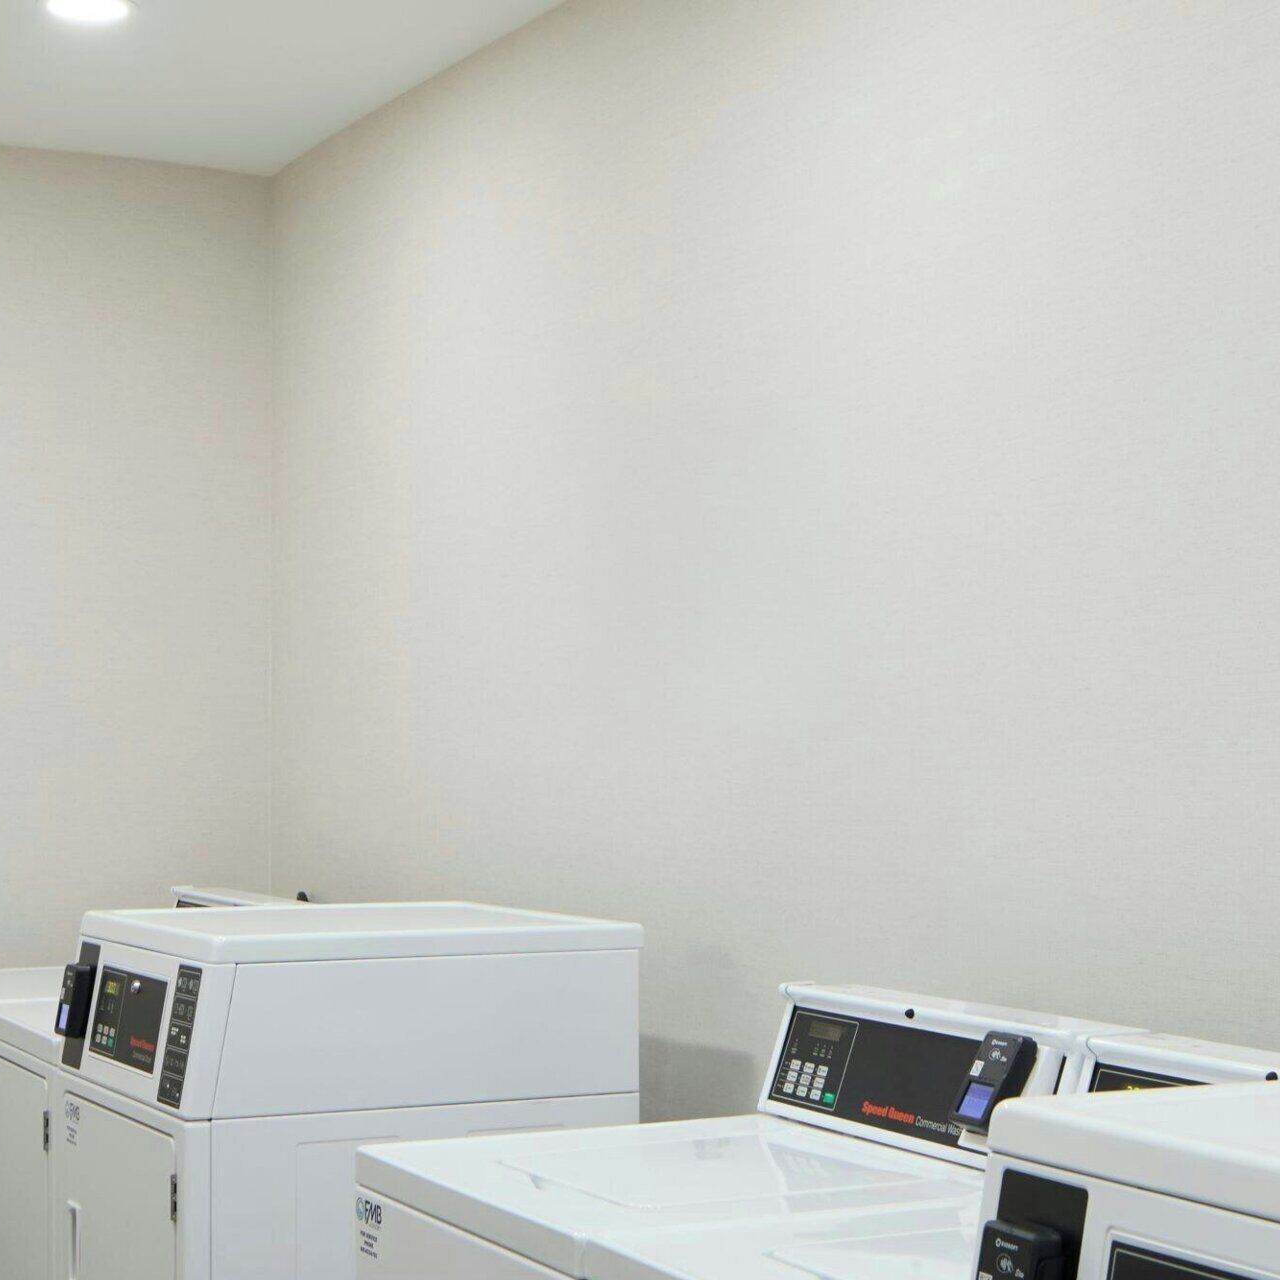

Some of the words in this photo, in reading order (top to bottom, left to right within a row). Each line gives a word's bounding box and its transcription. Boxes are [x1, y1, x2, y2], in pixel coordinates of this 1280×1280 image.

[862, 1100, 888, 1117] Speed
[888, 1107, 915, 1124] Queen
[915, 1115, 947, 1132] Commercial
[364, 1200, 382, 1224] FMB
